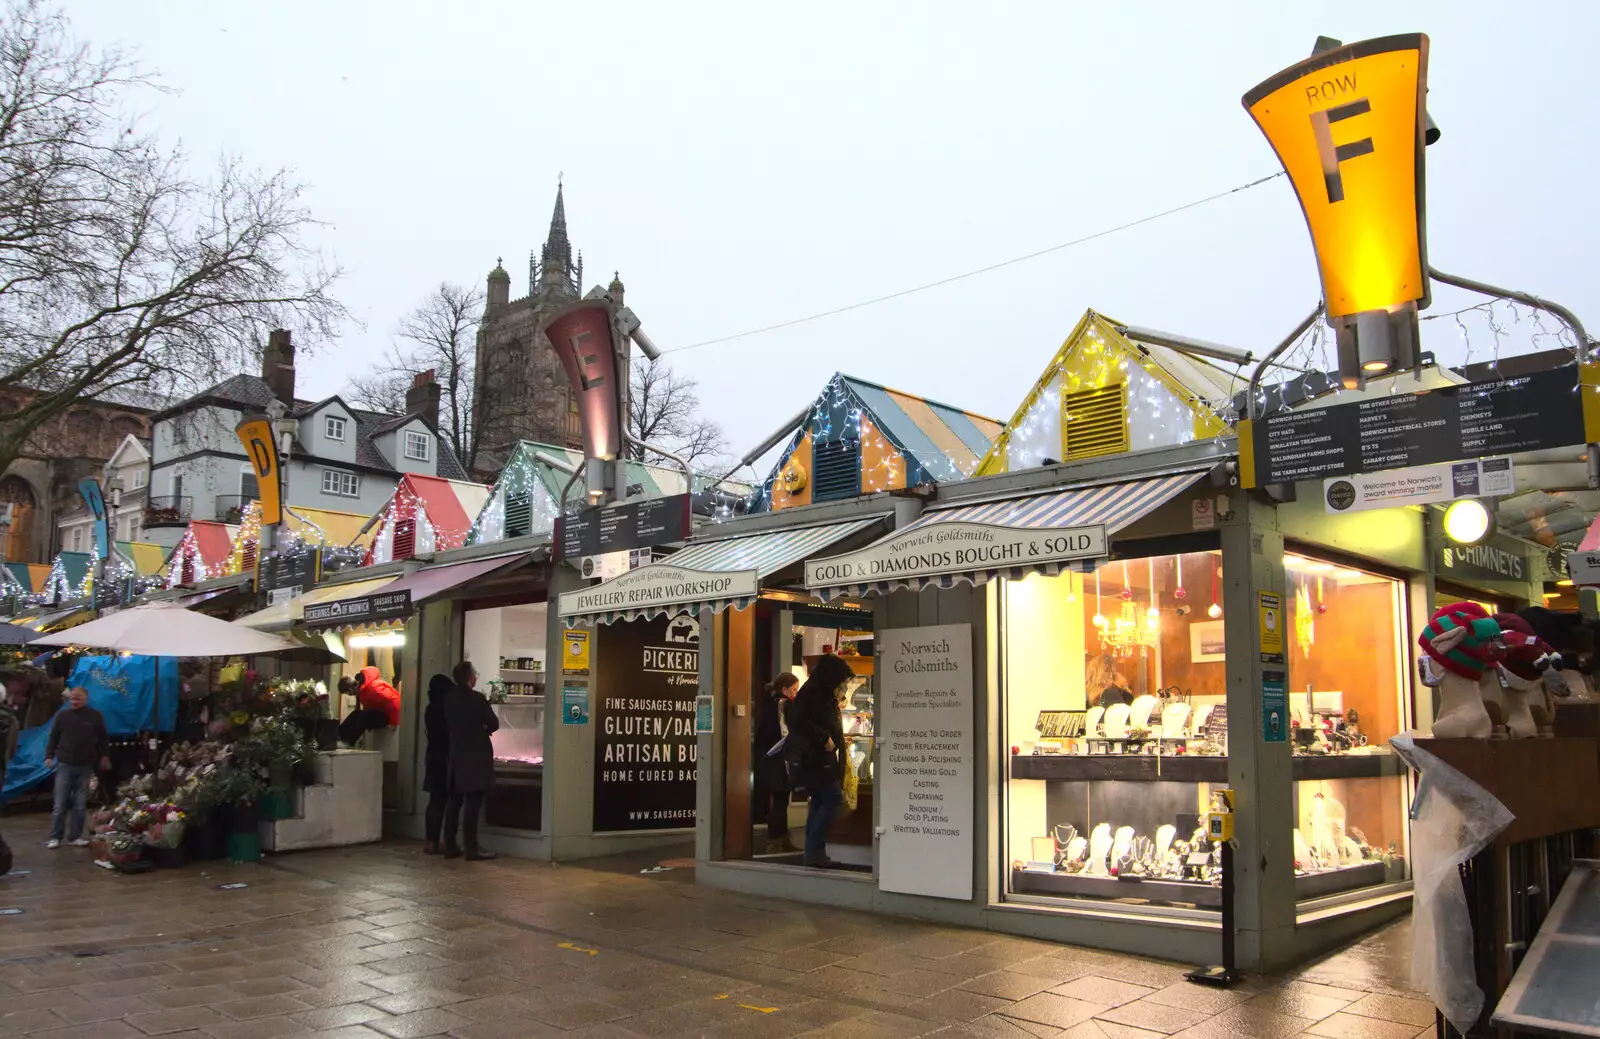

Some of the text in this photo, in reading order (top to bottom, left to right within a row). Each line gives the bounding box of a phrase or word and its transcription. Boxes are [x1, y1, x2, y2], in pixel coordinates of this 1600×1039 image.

[1305, 70, 1357, 105] ROW
[1309, 96, 1374, 204] F
[569, 330, 604, 391] E
[1472, 382, 1495, 392] JACKET
[1515, 377, 1530, 385] STOP
[1371, 400, 1390, 408] OTHER
[1391, 396, 1417, 404] CURATOR
[1268, 416, 1292, 424] NORWICH
[1293, 410, 1326, 420] GOLDSMITHS
[1360, 414, 1387, 423] HARVEY'S
[1460, 412, 1492, 421] CHIMNEYS
[1360, 428, 1387, 437] NORWICH
[1388, 423, 1422, 433] ELECTRICAL
[1424, 420, 1446, 428] STORES
[1461, 426, 1484, 434] MOBILE
[1270, 441, 1299, 450] HIMALAYAN
[1300, 435, 1331, 445] TREASURES
[1462, 439, 1486, 447] SUPPLY
[251, 438, 270, 477] D
[1271, 452, 1306, 462] WALSINGHAM
[1362, 453, 1408, 464] CANARY COMICS
[1309, 464, 1326, 472] CRAFT
[1327, 462, 1344, 470] STORE
[1363, 480, 1395, 490] Welcome
[1407, 475, 1442, 484] Norwich's
[1364, 483, 1442, 498] award winning market
[890, 528, 994, 555] Norwich Goldsmiths
[816, 534, 1091, 580] GOLD & DIAMONDS BOUGHT & SOLD
[617, 569, 684, 588] Norwich Goldsmiths
[577, 578, 731, 609] JEWELLERY REPAIR WORKSHOP
[374, 594, 406, 606] SAUSAGE SHOP
[306, 607, 330, 619] PICKERINGS
[342, 605, 348, 614] OF
[349, 602, 369, 613] NORWICH
[901, 639, 950, 655] Norwich
[644, 650, 696, 670] PICKERI
[894, 658, 958, 673] Goldsmiths
[668, 676, 674, 685] of
[896, 688, 956, 699] Jewellery Repairs &
[606, 698, 697, 712] FINE SAUSAGES MADE
[928, 700, 961, 709] Specialists
[940, 730, 962, 738] ORDER
[893, 742, 959, 750] STONE REPLACEMENT
[604, 744, 697, 762] ARTISAN BU
[928, 755, 962, 763] POLISHING
[603, 771, 633, 781] HOME
[640, 770, 673, 781] CURED
[913, 780, 939, 788] CASTING
[909, 792, 943, 800] ENGRAVING
[630, 810, 697, 820] WWW.SAUSAGESH
[909, 805, 938, 813] RHODIUM
[904, 813, 948, 822] GOLD PLATING
[894, 825, 960, 836] WRITTEN VALUATIONS
